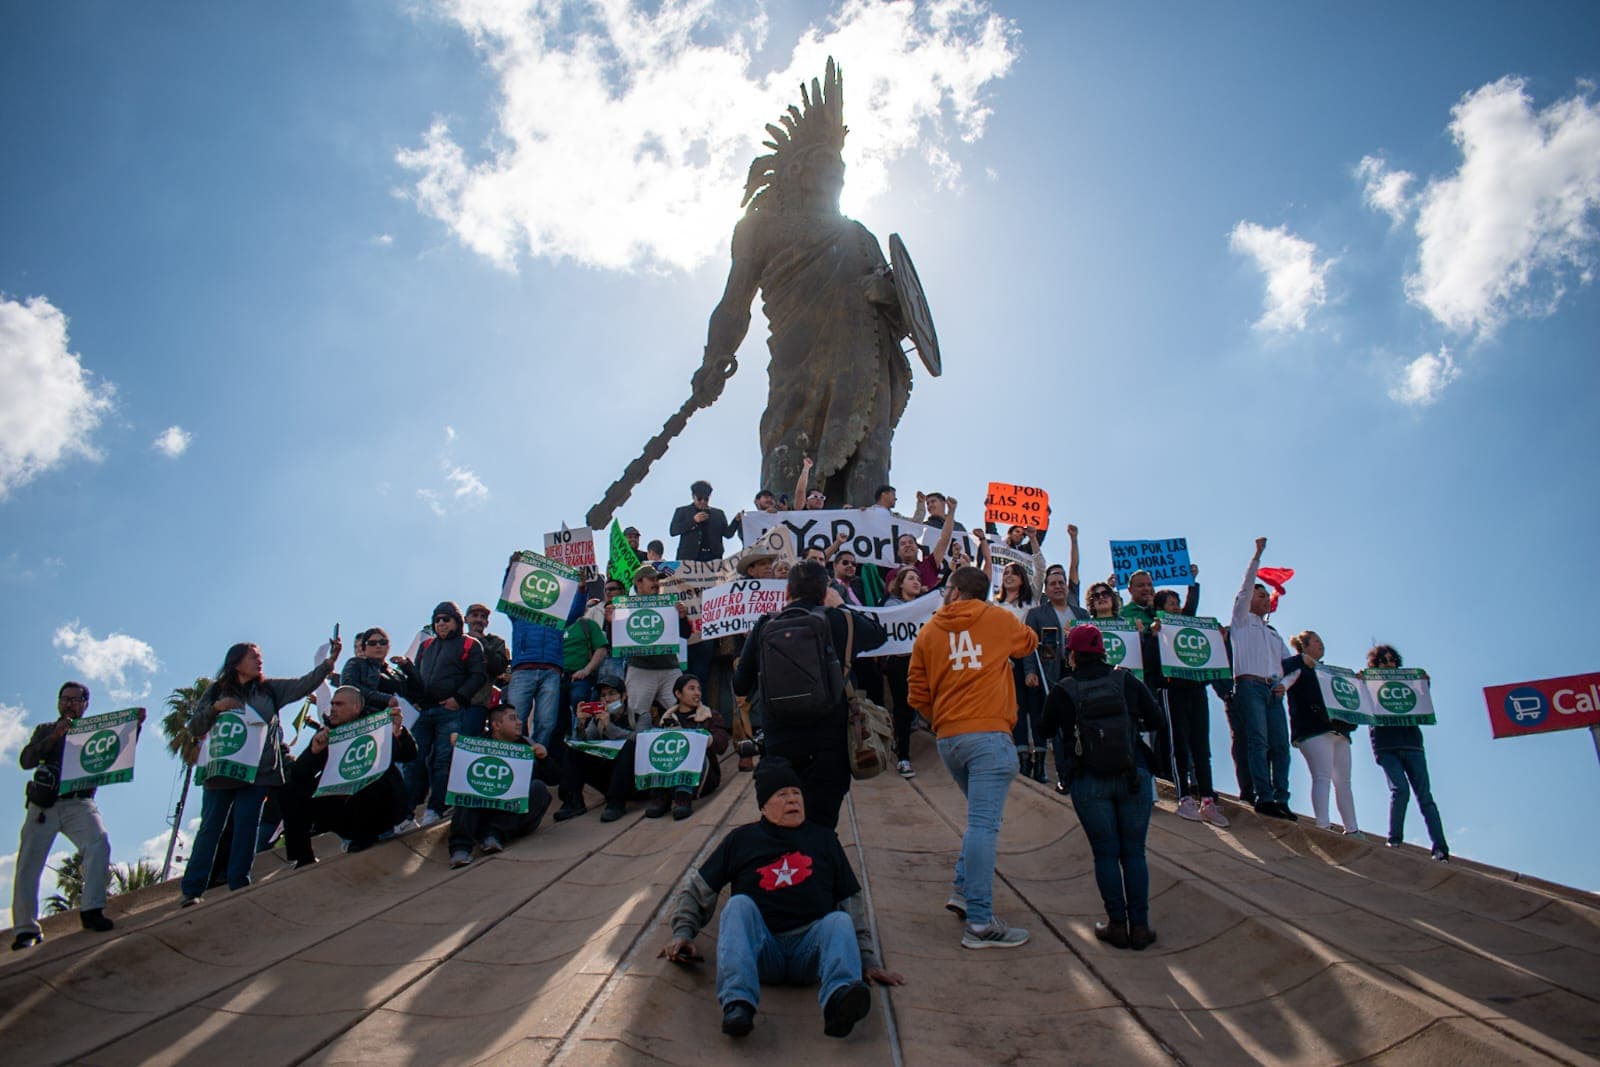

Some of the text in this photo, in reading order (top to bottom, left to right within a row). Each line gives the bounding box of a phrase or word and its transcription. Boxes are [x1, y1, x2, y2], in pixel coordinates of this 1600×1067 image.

[1013, 485, 1044, 498] POR
[989, 494, 1041, 511] LAS 40
[989, 509, 1041, 526] HORAS
[553, 530, 572, 544] NO
[1141, 543, 1163, 555] POR
[1167, 539, 1187, 552] LAS
[1137, 554, 1175, 569] HORAS
[525, 575, 558, 594] CCP
[730, 580, 762, 593] NO
[703, 590, 785, 611] QUIERO EXISTI
[702, 608, 722, 622] SOLO
[724, 604, 746, 618] PARA
[630, 615, 661, 629] CCP
[1177, 634, 1207, 650] CCP
[949, 630, 982, 671] LA
[1333, 680, 1356, 695] CCP
[1380, 687, 1412, 700] CCP
[85, 735, 117, 755] CCP
[344, 740, 375, 763] CCP
[653, 739, 687, 755] CCP
[229, 764, 248, 779] 83
[471, 762, 510, 780] CCP
